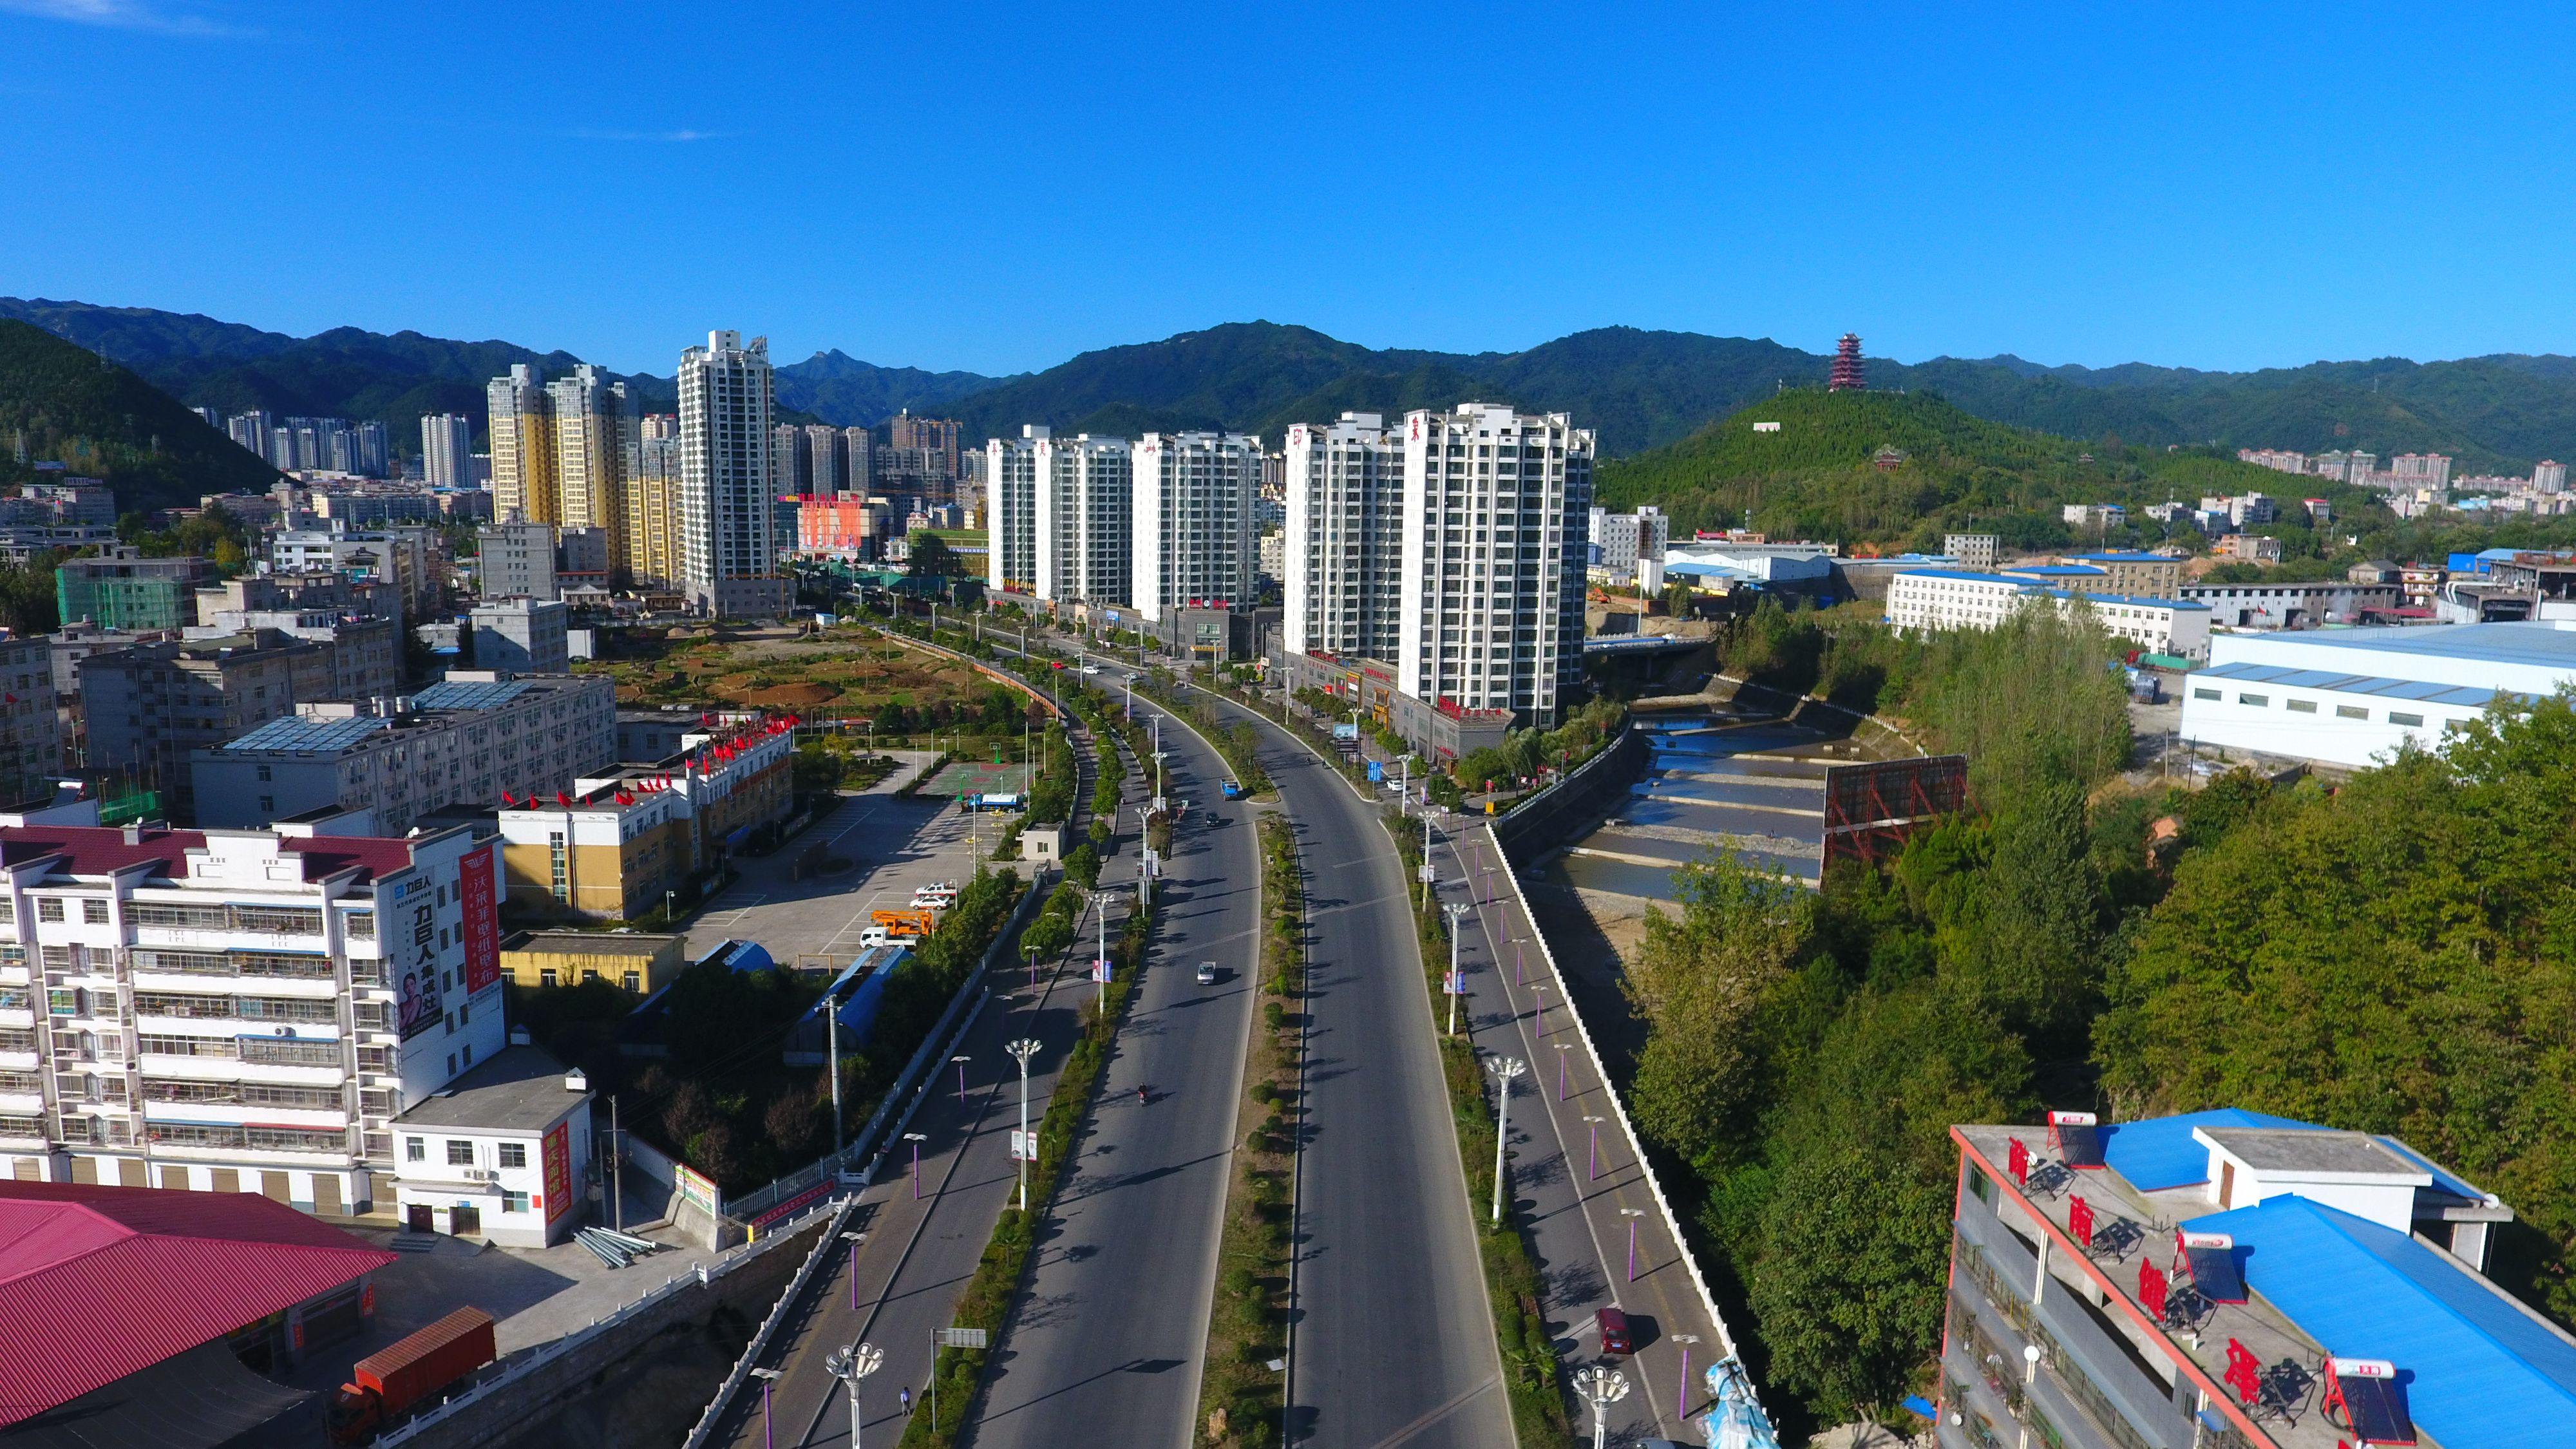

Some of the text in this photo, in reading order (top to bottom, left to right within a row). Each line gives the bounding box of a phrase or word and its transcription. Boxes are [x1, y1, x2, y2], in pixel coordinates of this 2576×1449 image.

[1293, 428, 1302, 450] 印
[406, 875, 431, 896] 力巨人
[413, 904, 436, 1012] 力巨人集成灶
